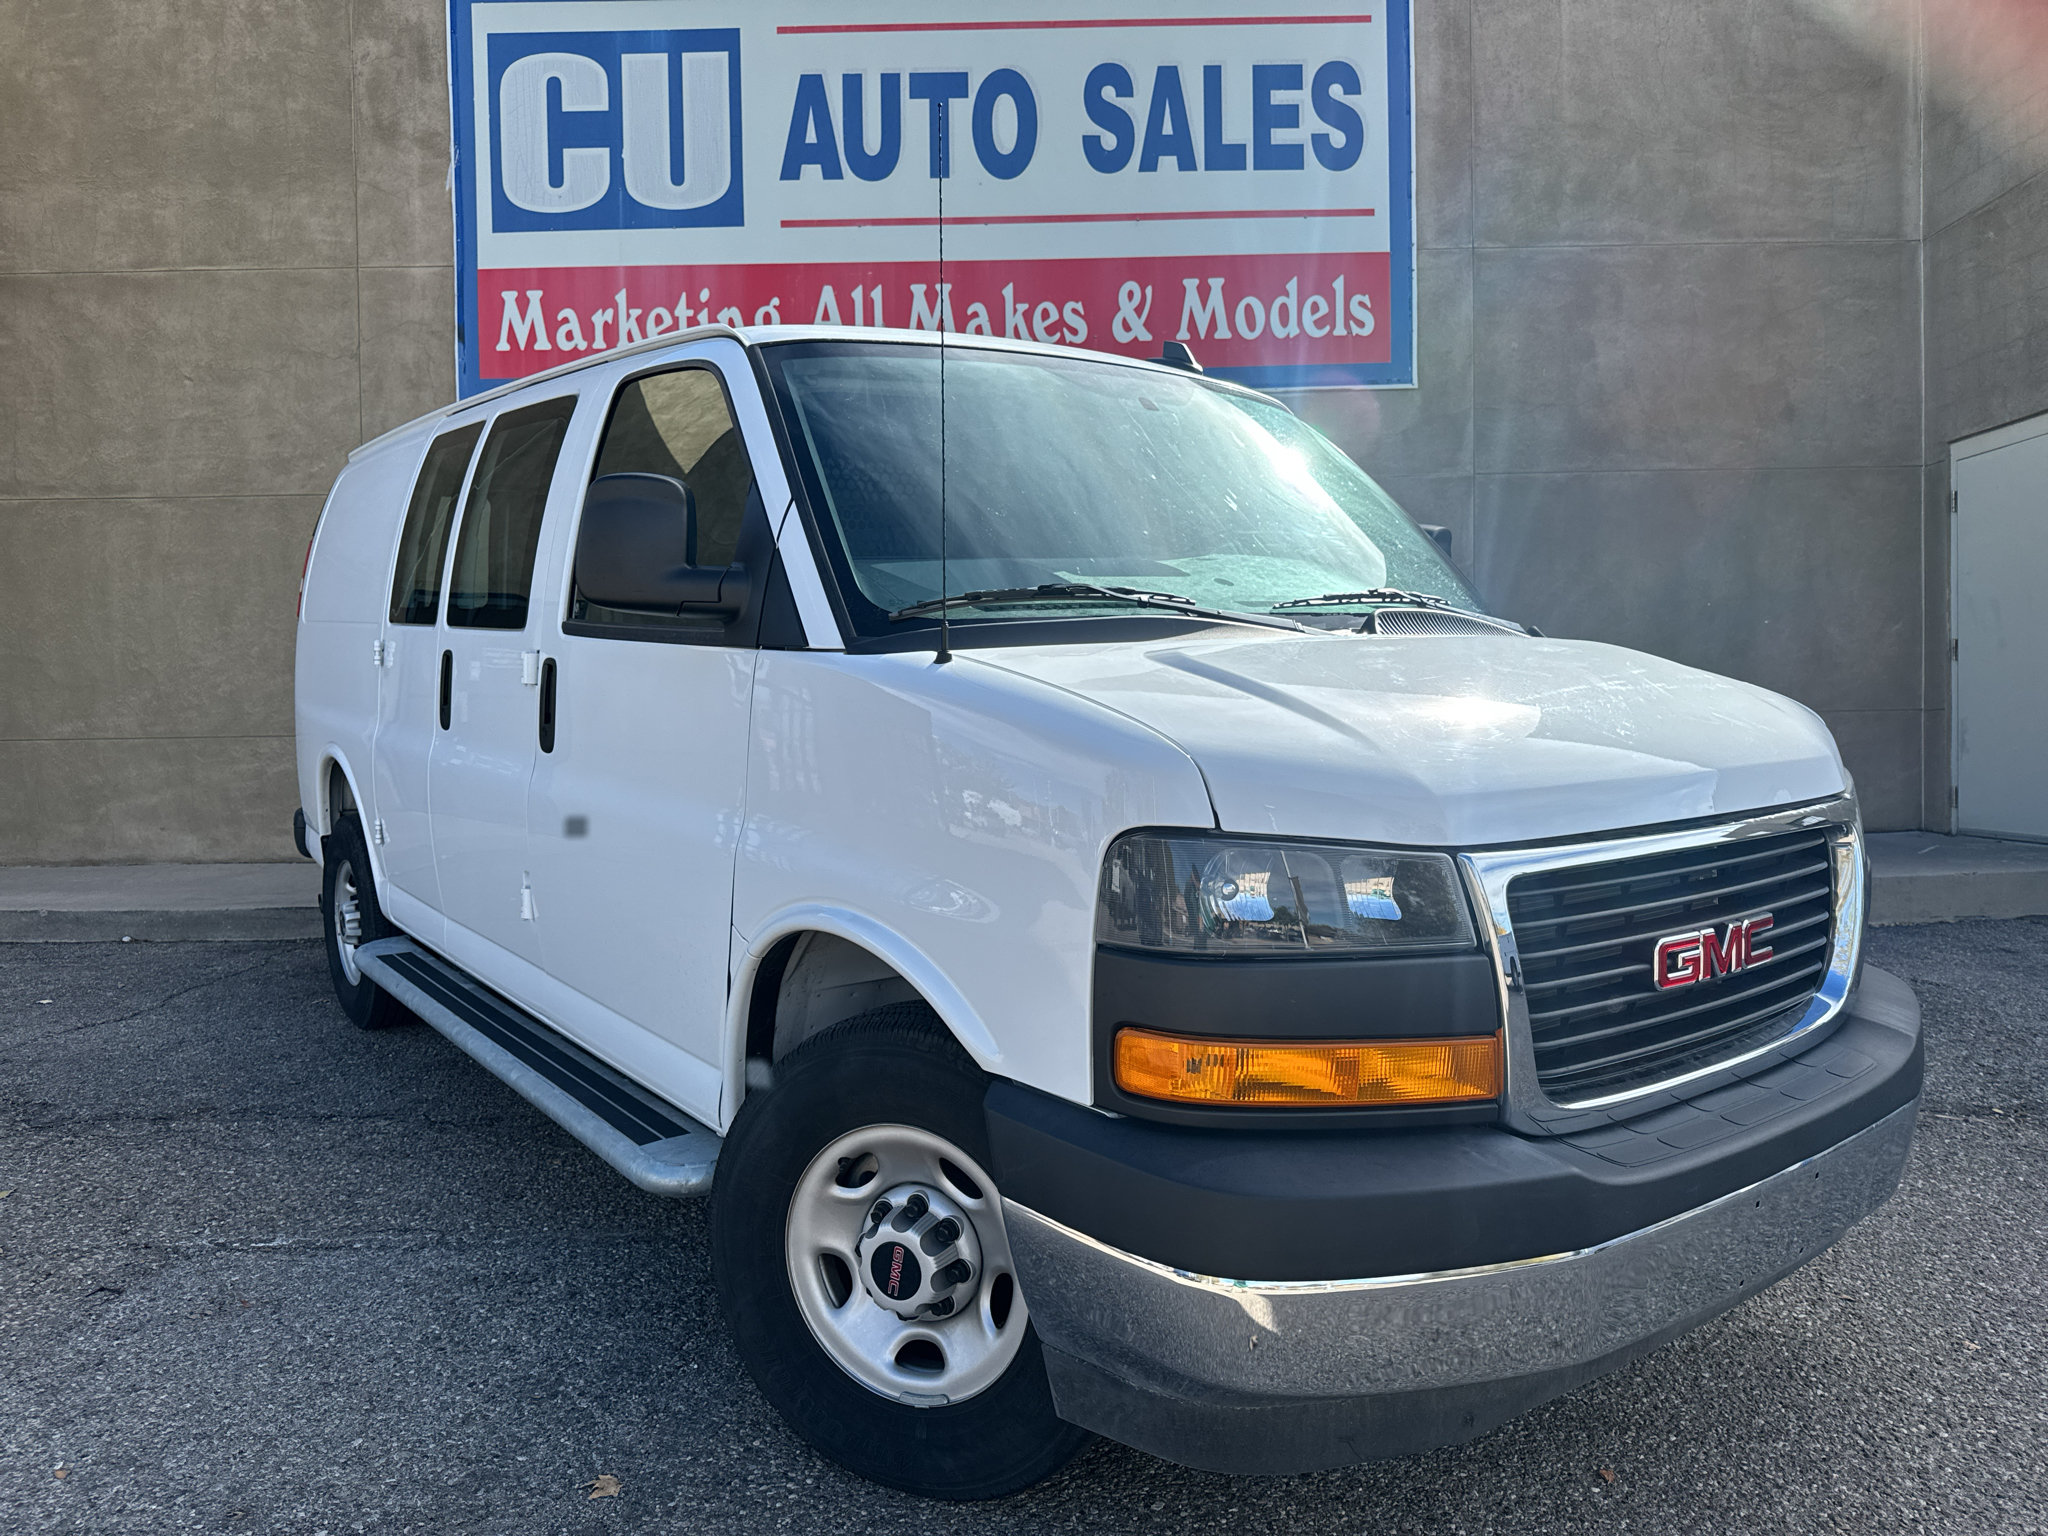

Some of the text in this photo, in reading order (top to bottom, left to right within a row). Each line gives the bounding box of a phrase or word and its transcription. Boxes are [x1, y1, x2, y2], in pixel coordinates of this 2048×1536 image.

[500, 51, 1364, 213] CU AUTO SALES
[813, 283, 885, 328] All
[908, 282, 1088, 344] Makes
[1112, 280, 1153, 343] &
[1176, 275, 1375, 340] Models
[1654, 911, 1774, 991] GMC
[888, 1246, 904, 1296] GMC
